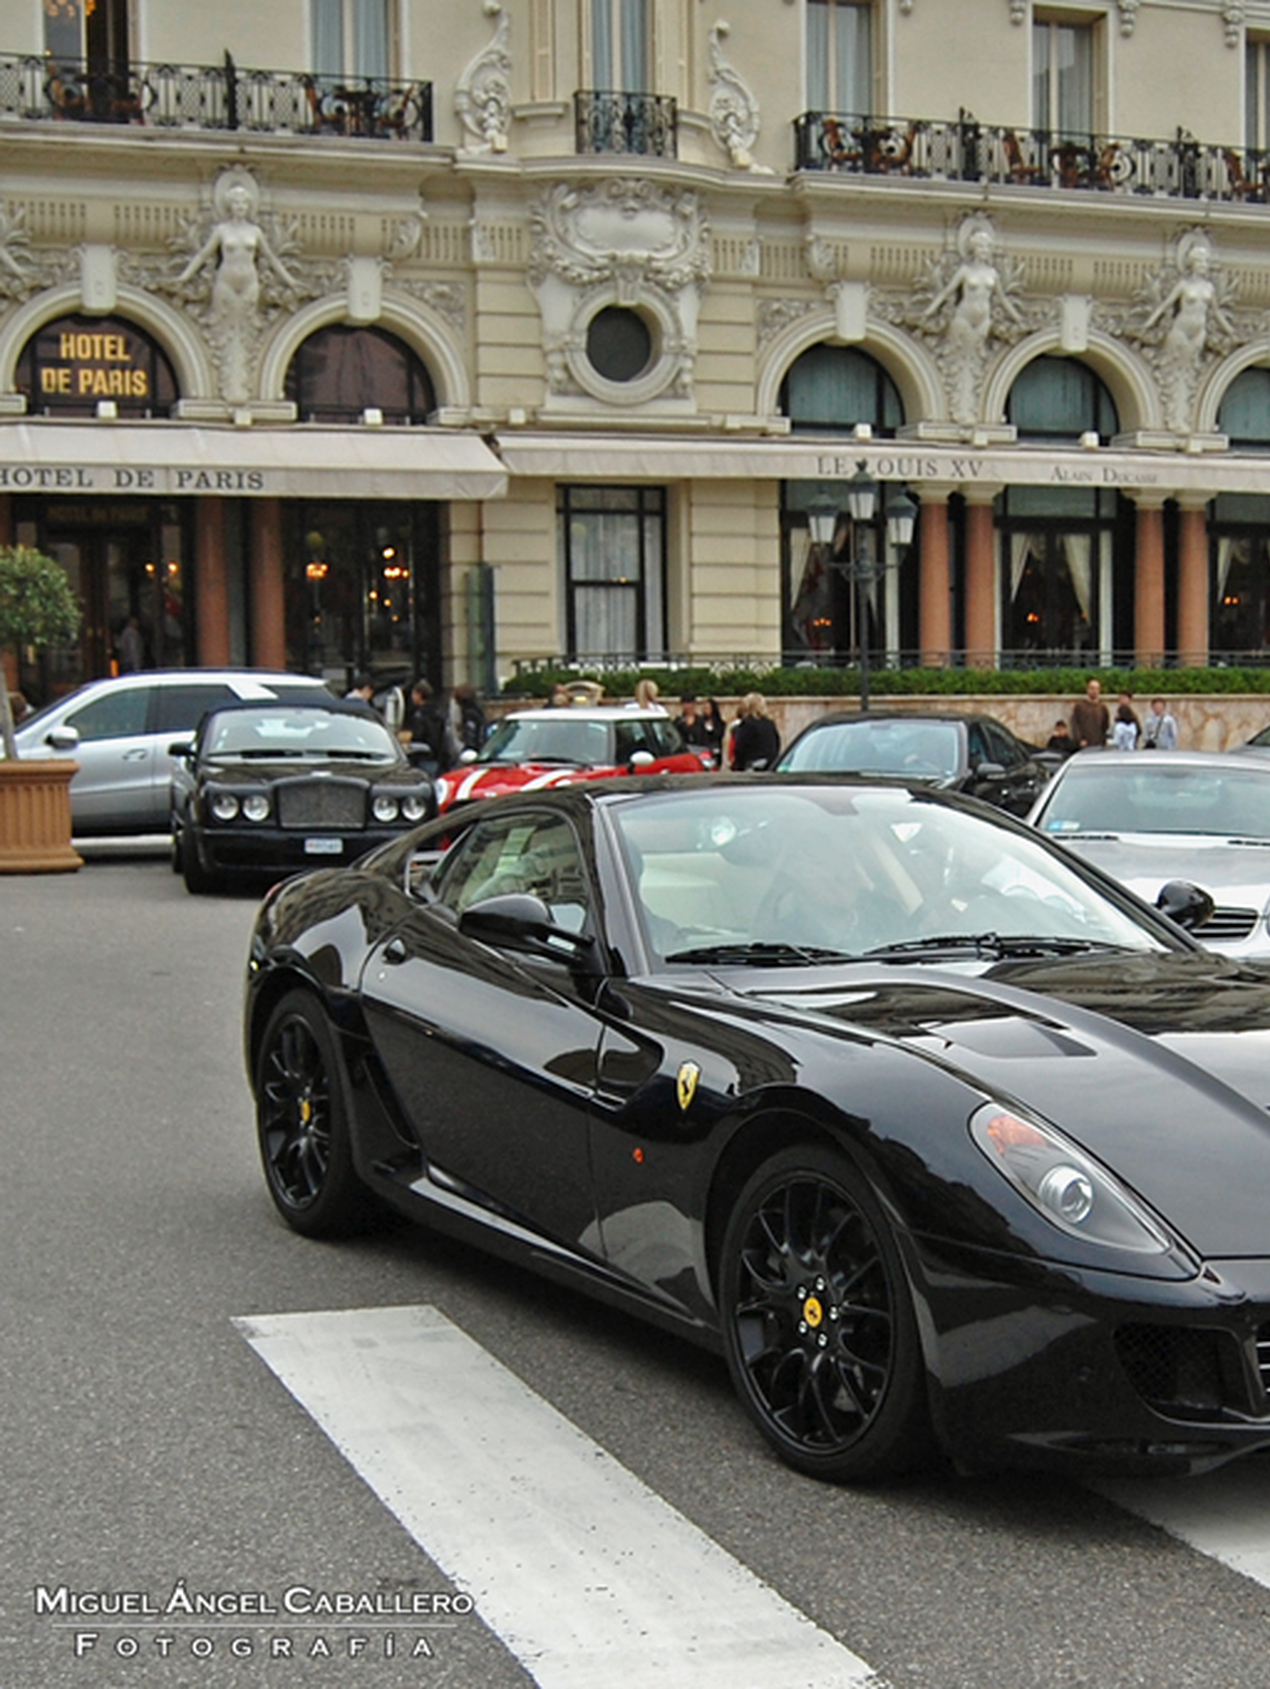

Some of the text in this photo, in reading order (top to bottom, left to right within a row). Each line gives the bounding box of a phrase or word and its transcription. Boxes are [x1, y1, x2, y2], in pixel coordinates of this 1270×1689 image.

[60, 333, 130, 361] HOTEL
[41, 367, 148, 396] DE PARIS
[115, 469, 154, 488] DE
[177, 471, 264, 490] PARIS
[817, 457, 983, 478] LE OUIS XV
